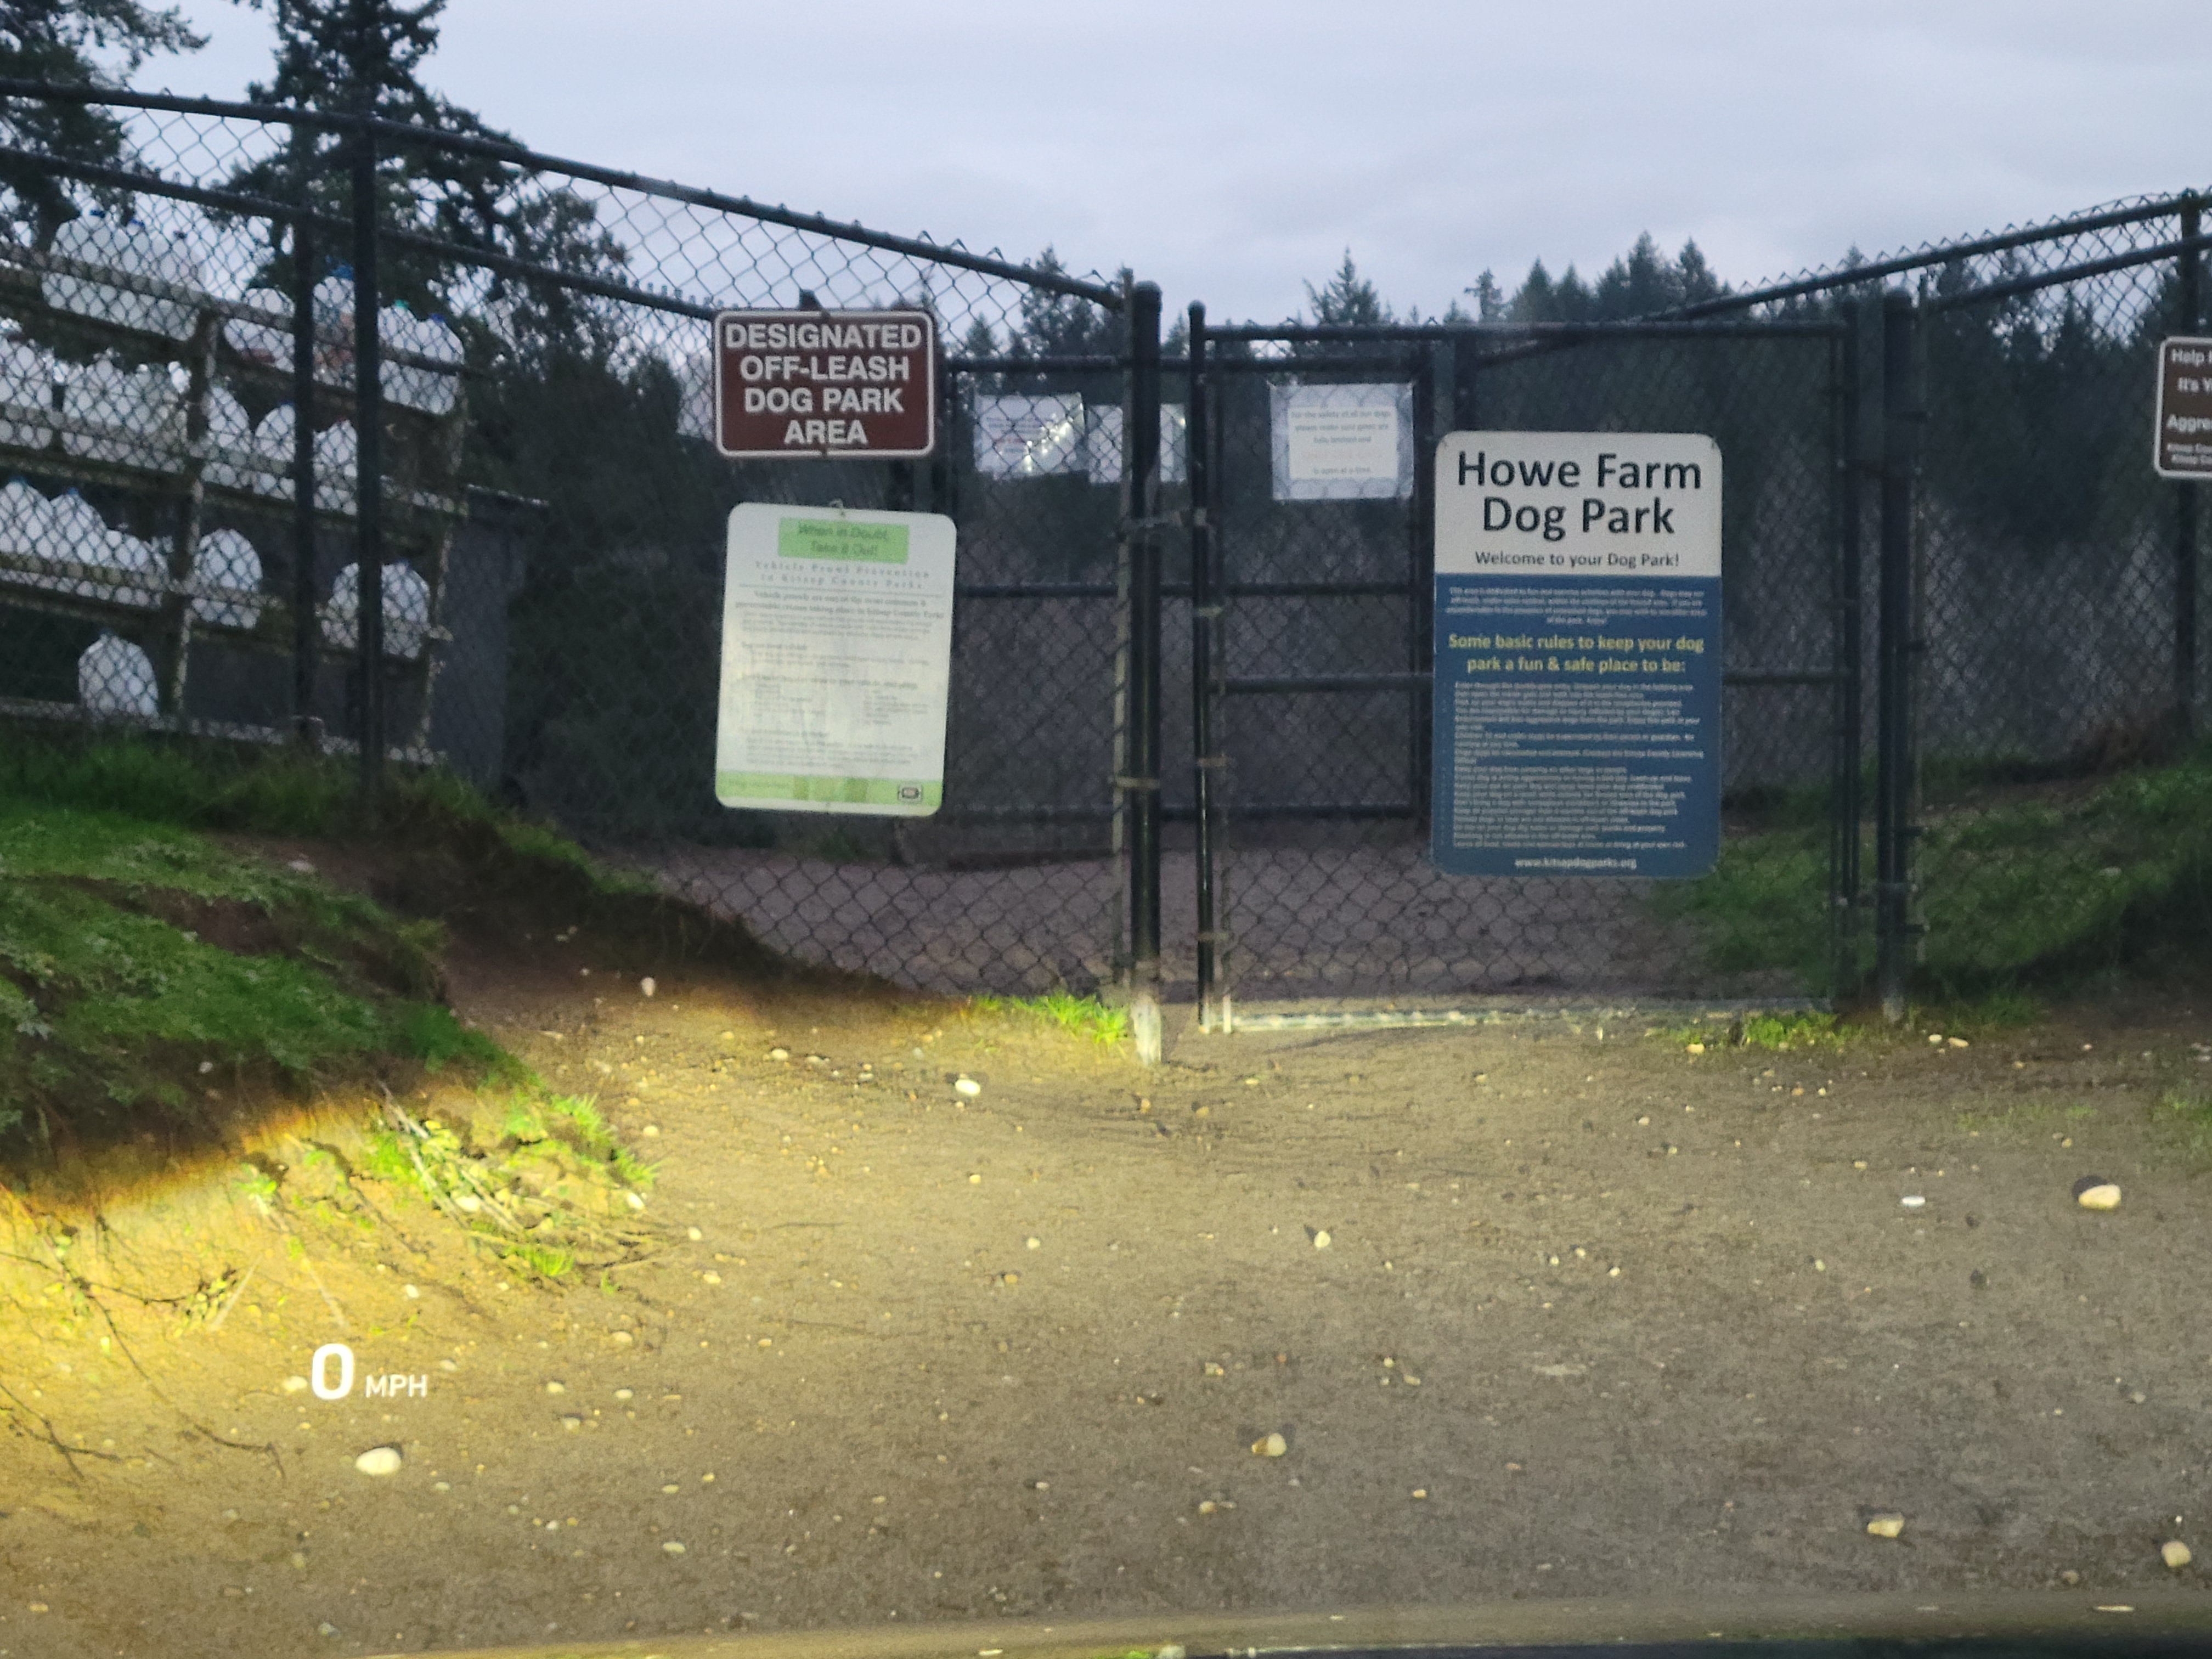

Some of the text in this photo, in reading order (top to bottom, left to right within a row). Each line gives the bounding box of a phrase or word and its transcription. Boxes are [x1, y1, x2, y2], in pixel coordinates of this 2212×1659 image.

[726, 323, 922, 349] DESIGNATED
[740, 355, 910, 381] OFF-LEASH
[2171, 348, 2205, 366] Help
[744, 387, 904, 413] DOG PARK
[784, 420, 868, 445] AREA
[2166, 414, 2212, 432] Aggre
[1458, 451, 1701, 489] Howe Farm
[1483, 496, 1674, 541] Dog Park
[1475, 551, 1679, 571] Welcome to your Dog Park!
[1449, 633, 1704, 653] Some basic rules to keep your dog
[1467, 656, 1685, 674] park a fun & safe place to be:
[312, 1343, 428, 1400] 0 MPH
